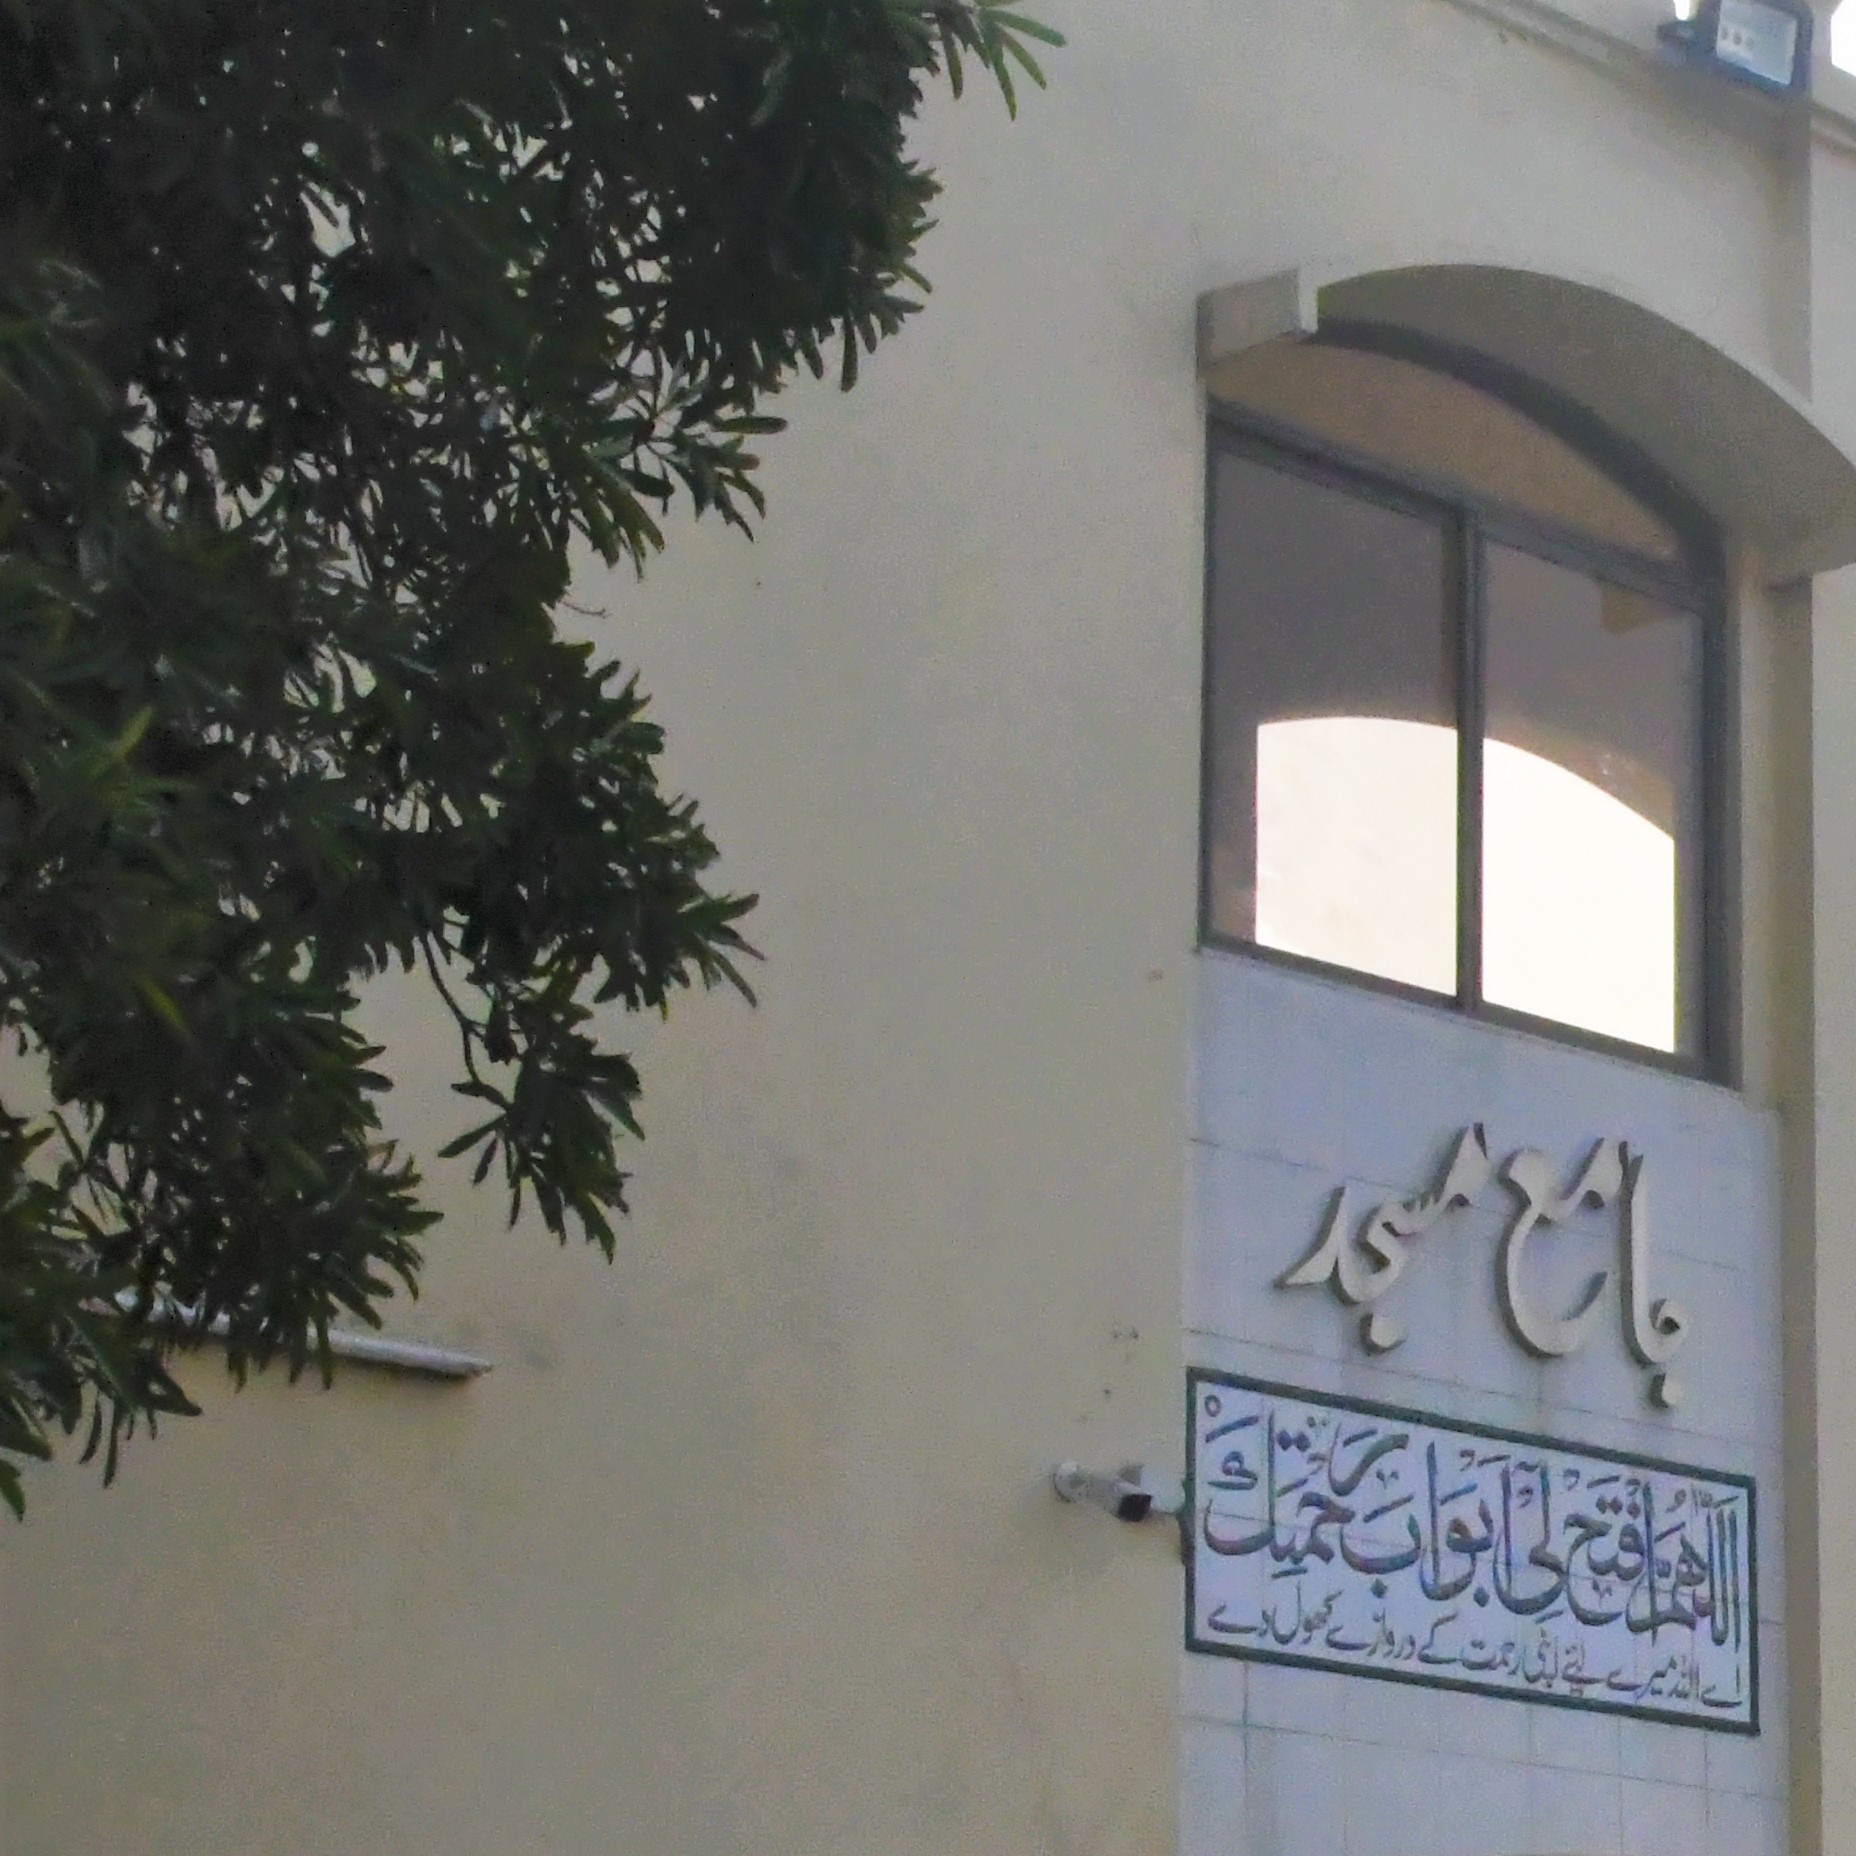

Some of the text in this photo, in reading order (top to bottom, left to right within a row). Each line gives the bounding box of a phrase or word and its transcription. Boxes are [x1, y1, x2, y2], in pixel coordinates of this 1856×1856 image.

[1272, 1122, 1690, 1410] جامع مسجد
[1460, 1639, 1523, 1676] رحمت
